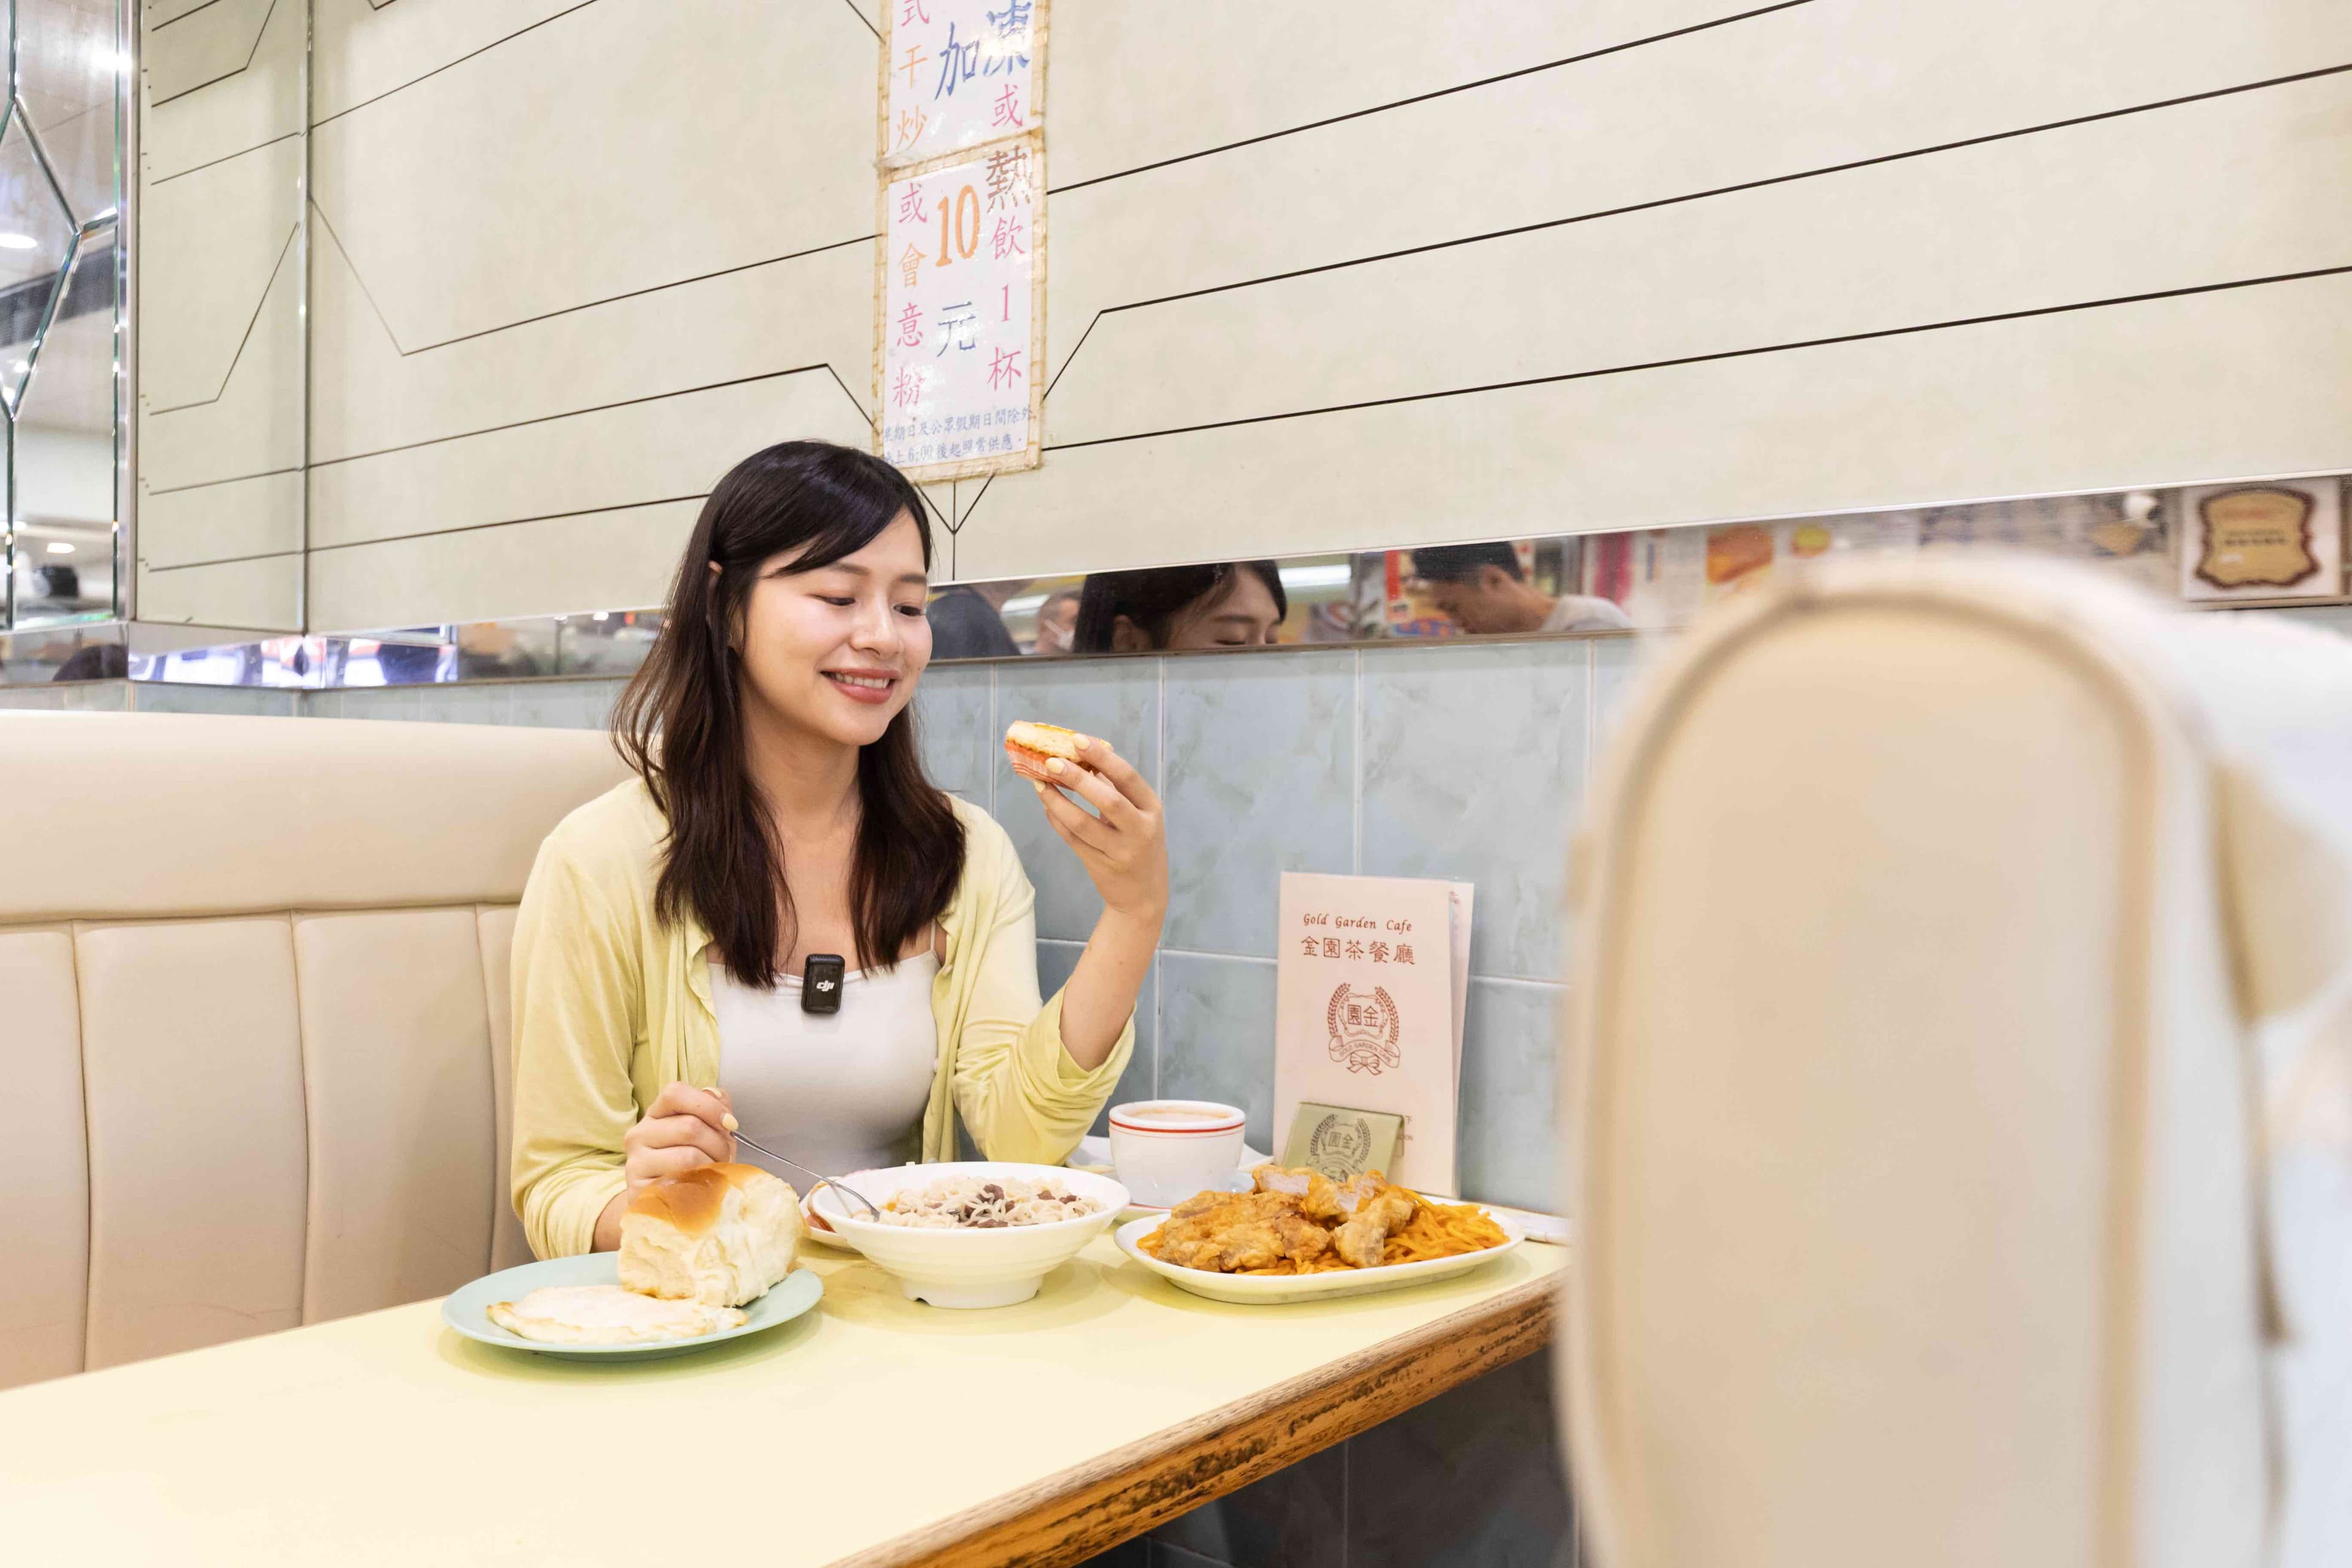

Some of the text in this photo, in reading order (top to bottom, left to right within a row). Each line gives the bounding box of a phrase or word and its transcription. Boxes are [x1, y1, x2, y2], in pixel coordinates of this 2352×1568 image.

[1303, 913, 1412, 935] Gold Garden Cafe
[1301, 935, 1415, 965] 金園茶餐廳
